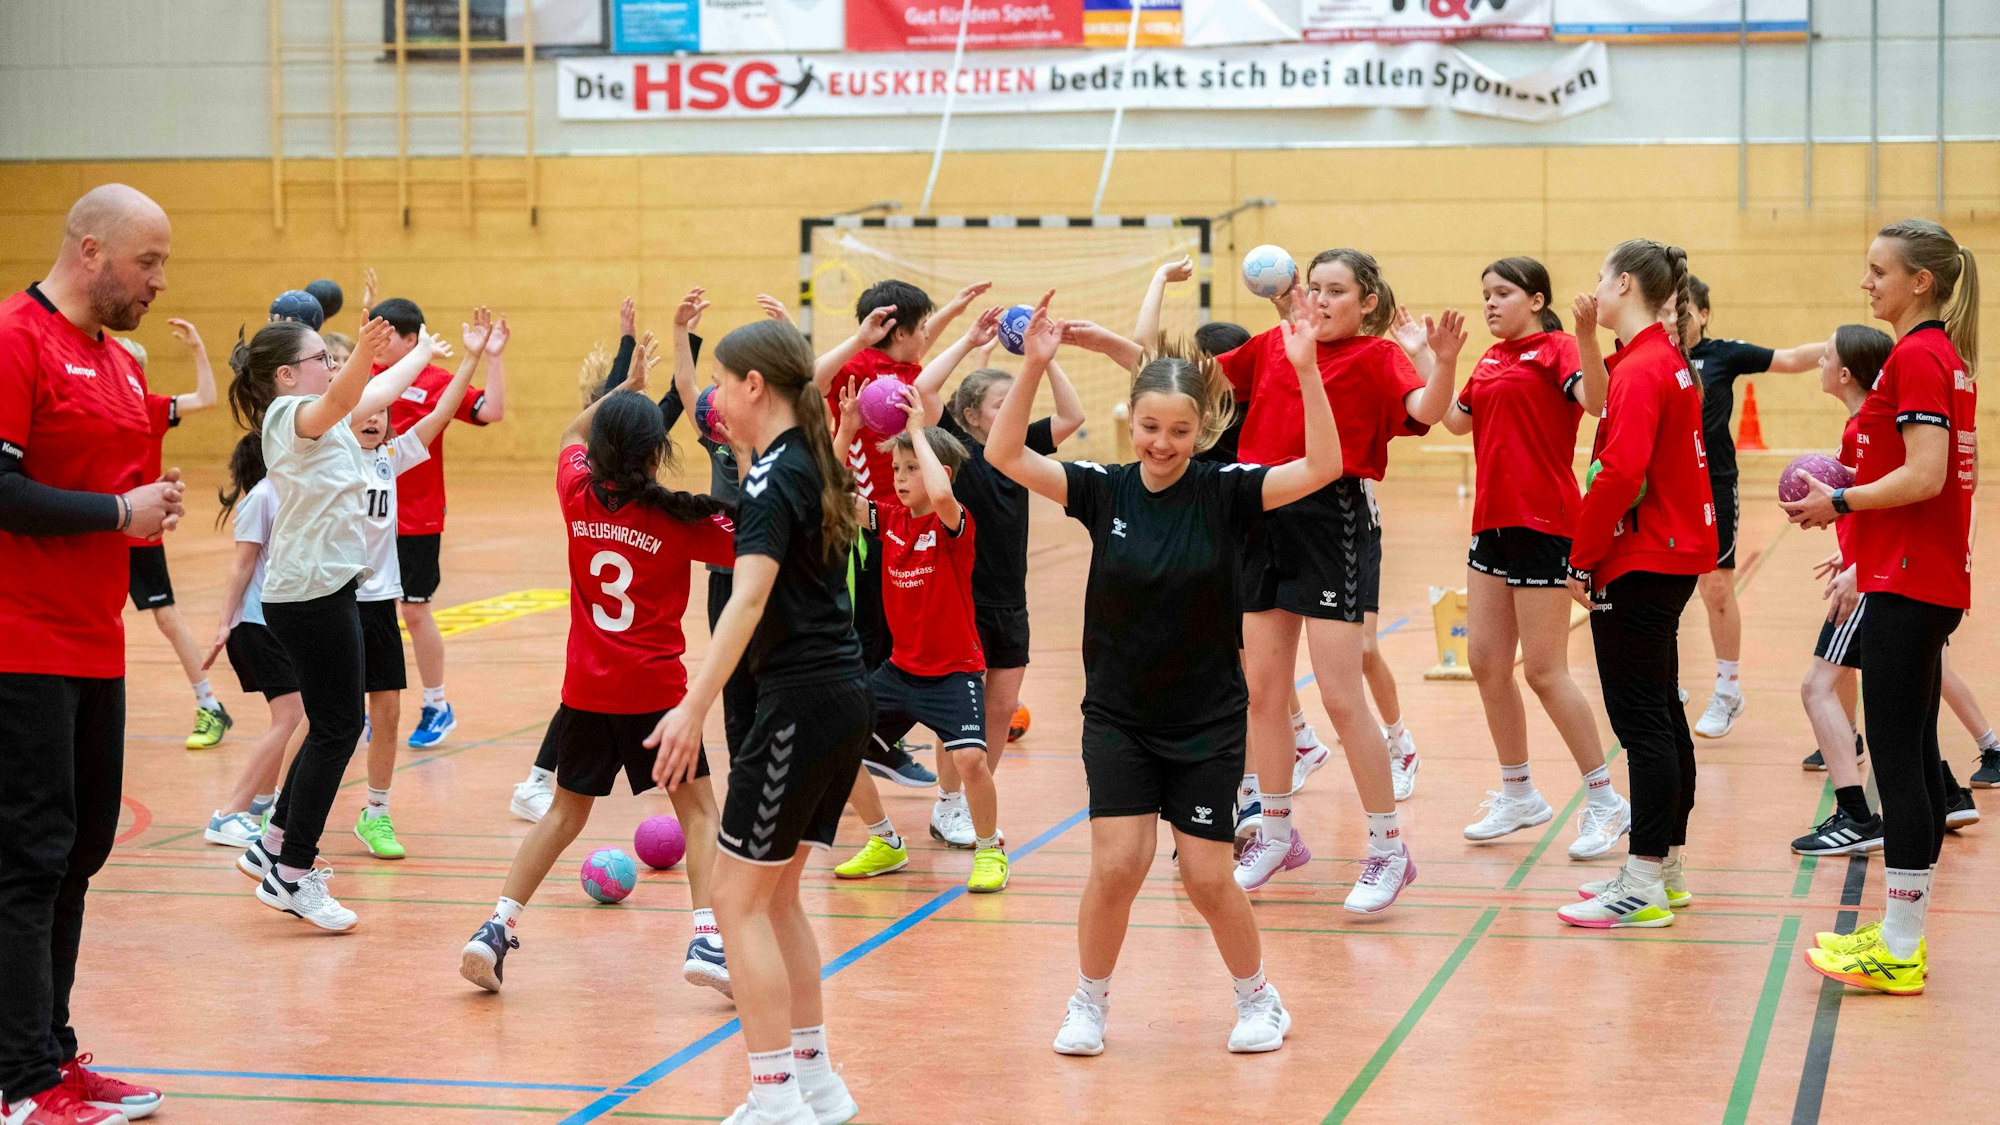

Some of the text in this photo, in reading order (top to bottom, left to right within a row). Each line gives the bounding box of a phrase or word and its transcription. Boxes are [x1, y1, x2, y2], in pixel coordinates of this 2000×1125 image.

[905, 6, 937, 25] Gut
[1002, 4, 1055, 24] Sport.
[576, 75, 625, 101] Die
[633, 61, 781, 111] HSG
[829, 67, 1036, 97] EUSKIRCHEN
[1050, 61, 1187, 92] bedankt
[1200, 59, 1265, 89] sich
[1280, 61, 1331, 88] bei
[1344, 60, 1423, 88] allen
[65, 363, 96, 379] Kempa
[1915, 412, 1942, 423] Kempa
[2, 441, 24, 459] Kemp
[366, 488, 388, 517] 10
[571, 520, 663, 555] HSG EUSKIRCHEN
[886, 529, 906, 547] Kempa
[1526, 577, 1549, 586] Kempa
[590, 550, 635, 632] 3
[1889, 887, 1920, 897] HSG
